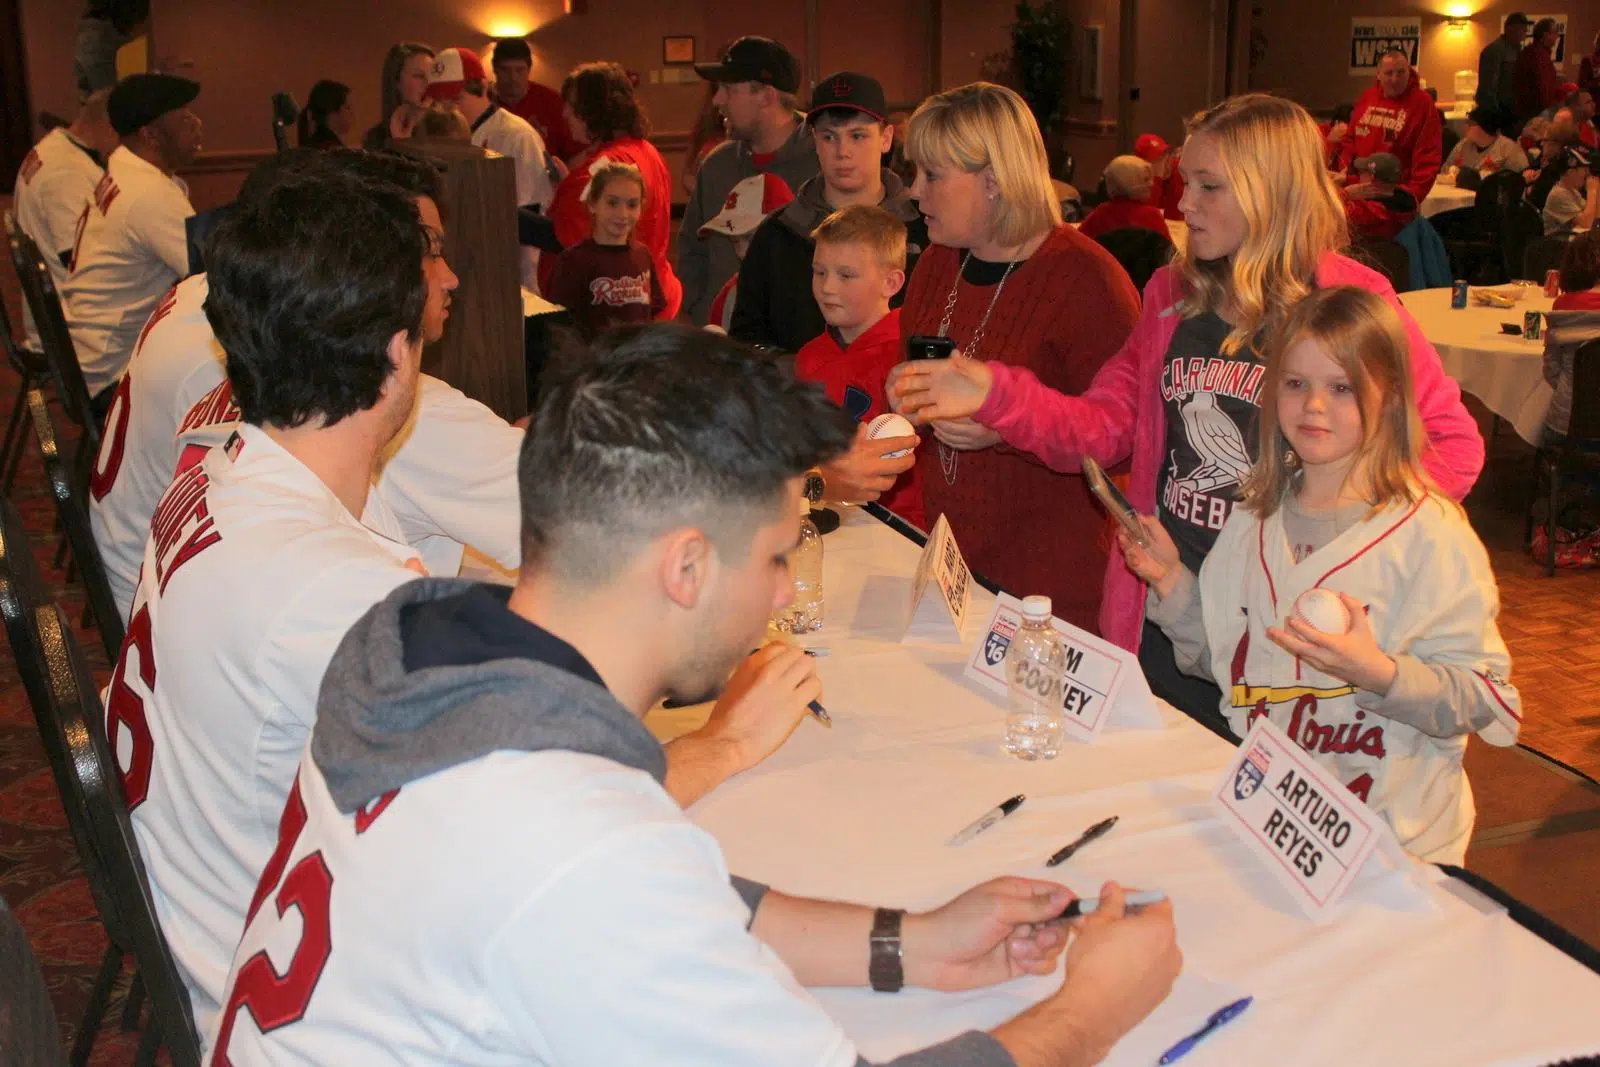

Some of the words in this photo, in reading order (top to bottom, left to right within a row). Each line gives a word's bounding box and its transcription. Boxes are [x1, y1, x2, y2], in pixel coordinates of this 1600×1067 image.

[1287, 693, 1386, 760] Louis
[1263, 808, 1323, 878] REYES
[1275, 769, 1352, 848] ARTURO
